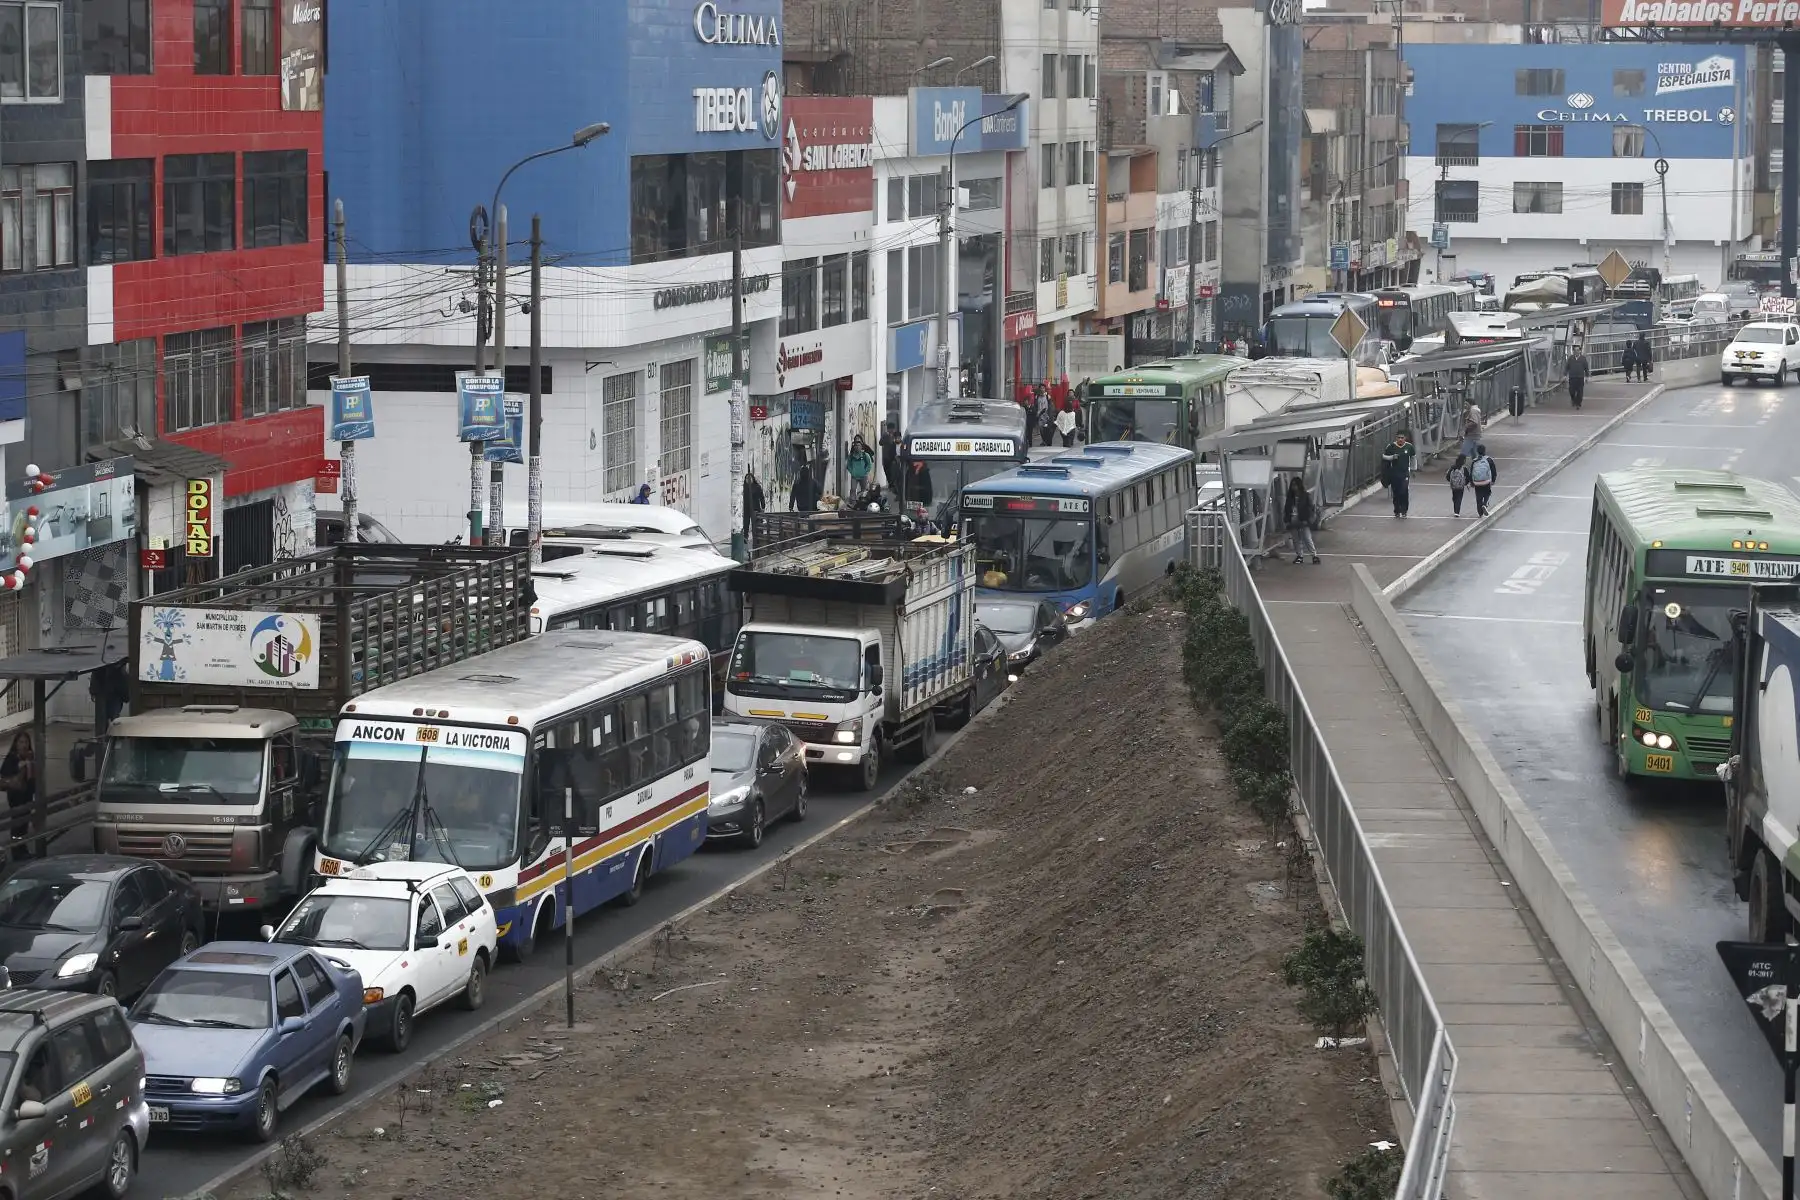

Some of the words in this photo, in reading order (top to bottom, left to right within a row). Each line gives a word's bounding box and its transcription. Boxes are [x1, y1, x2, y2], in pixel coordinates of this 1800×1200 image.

[1620, 0, 1733, 22] Acabados
[1736, 0, 1800, 22] Perfe
[694, 1, 780, 45] CELIMA
[1657, 63, 1692, 74] CENTRO
[1659, 69, 1731, 88] ESPECIALISTA
[693, 87, 757, 132] TREBOL
[1537, 109, 1629, 122] CELIMA
[1644, 109, 1713, 122] TREBOL
[803, 145, 827, 171] SAN
[914, 441, 951, 452] CARABAYLLO
[974, 442, 1010, 453] CARABAYLLO
[188, 480, 208, 555] DOLAR
[1694, 559, 1725, 573] ATE
[1732, 562, 1749, 573] 9401
[1754, 561, 1799, 577] VENTANILL
[1636, 709, 1651, 721] 203
[352, 725, 406, 741] ANCON
[417, 729, 438, 741] 1608
[445, 732, 459, 746] LA
[462, 733, 510, 750] VICTORIA
[1647, 756, 1671, 770] 9401
[321, 859, 340, 875] 1608
[481, 875, 491, 887] 10
[1748, 969, 1774, 978] 01-2017
[1752, 962, 1771, 970] MTC
